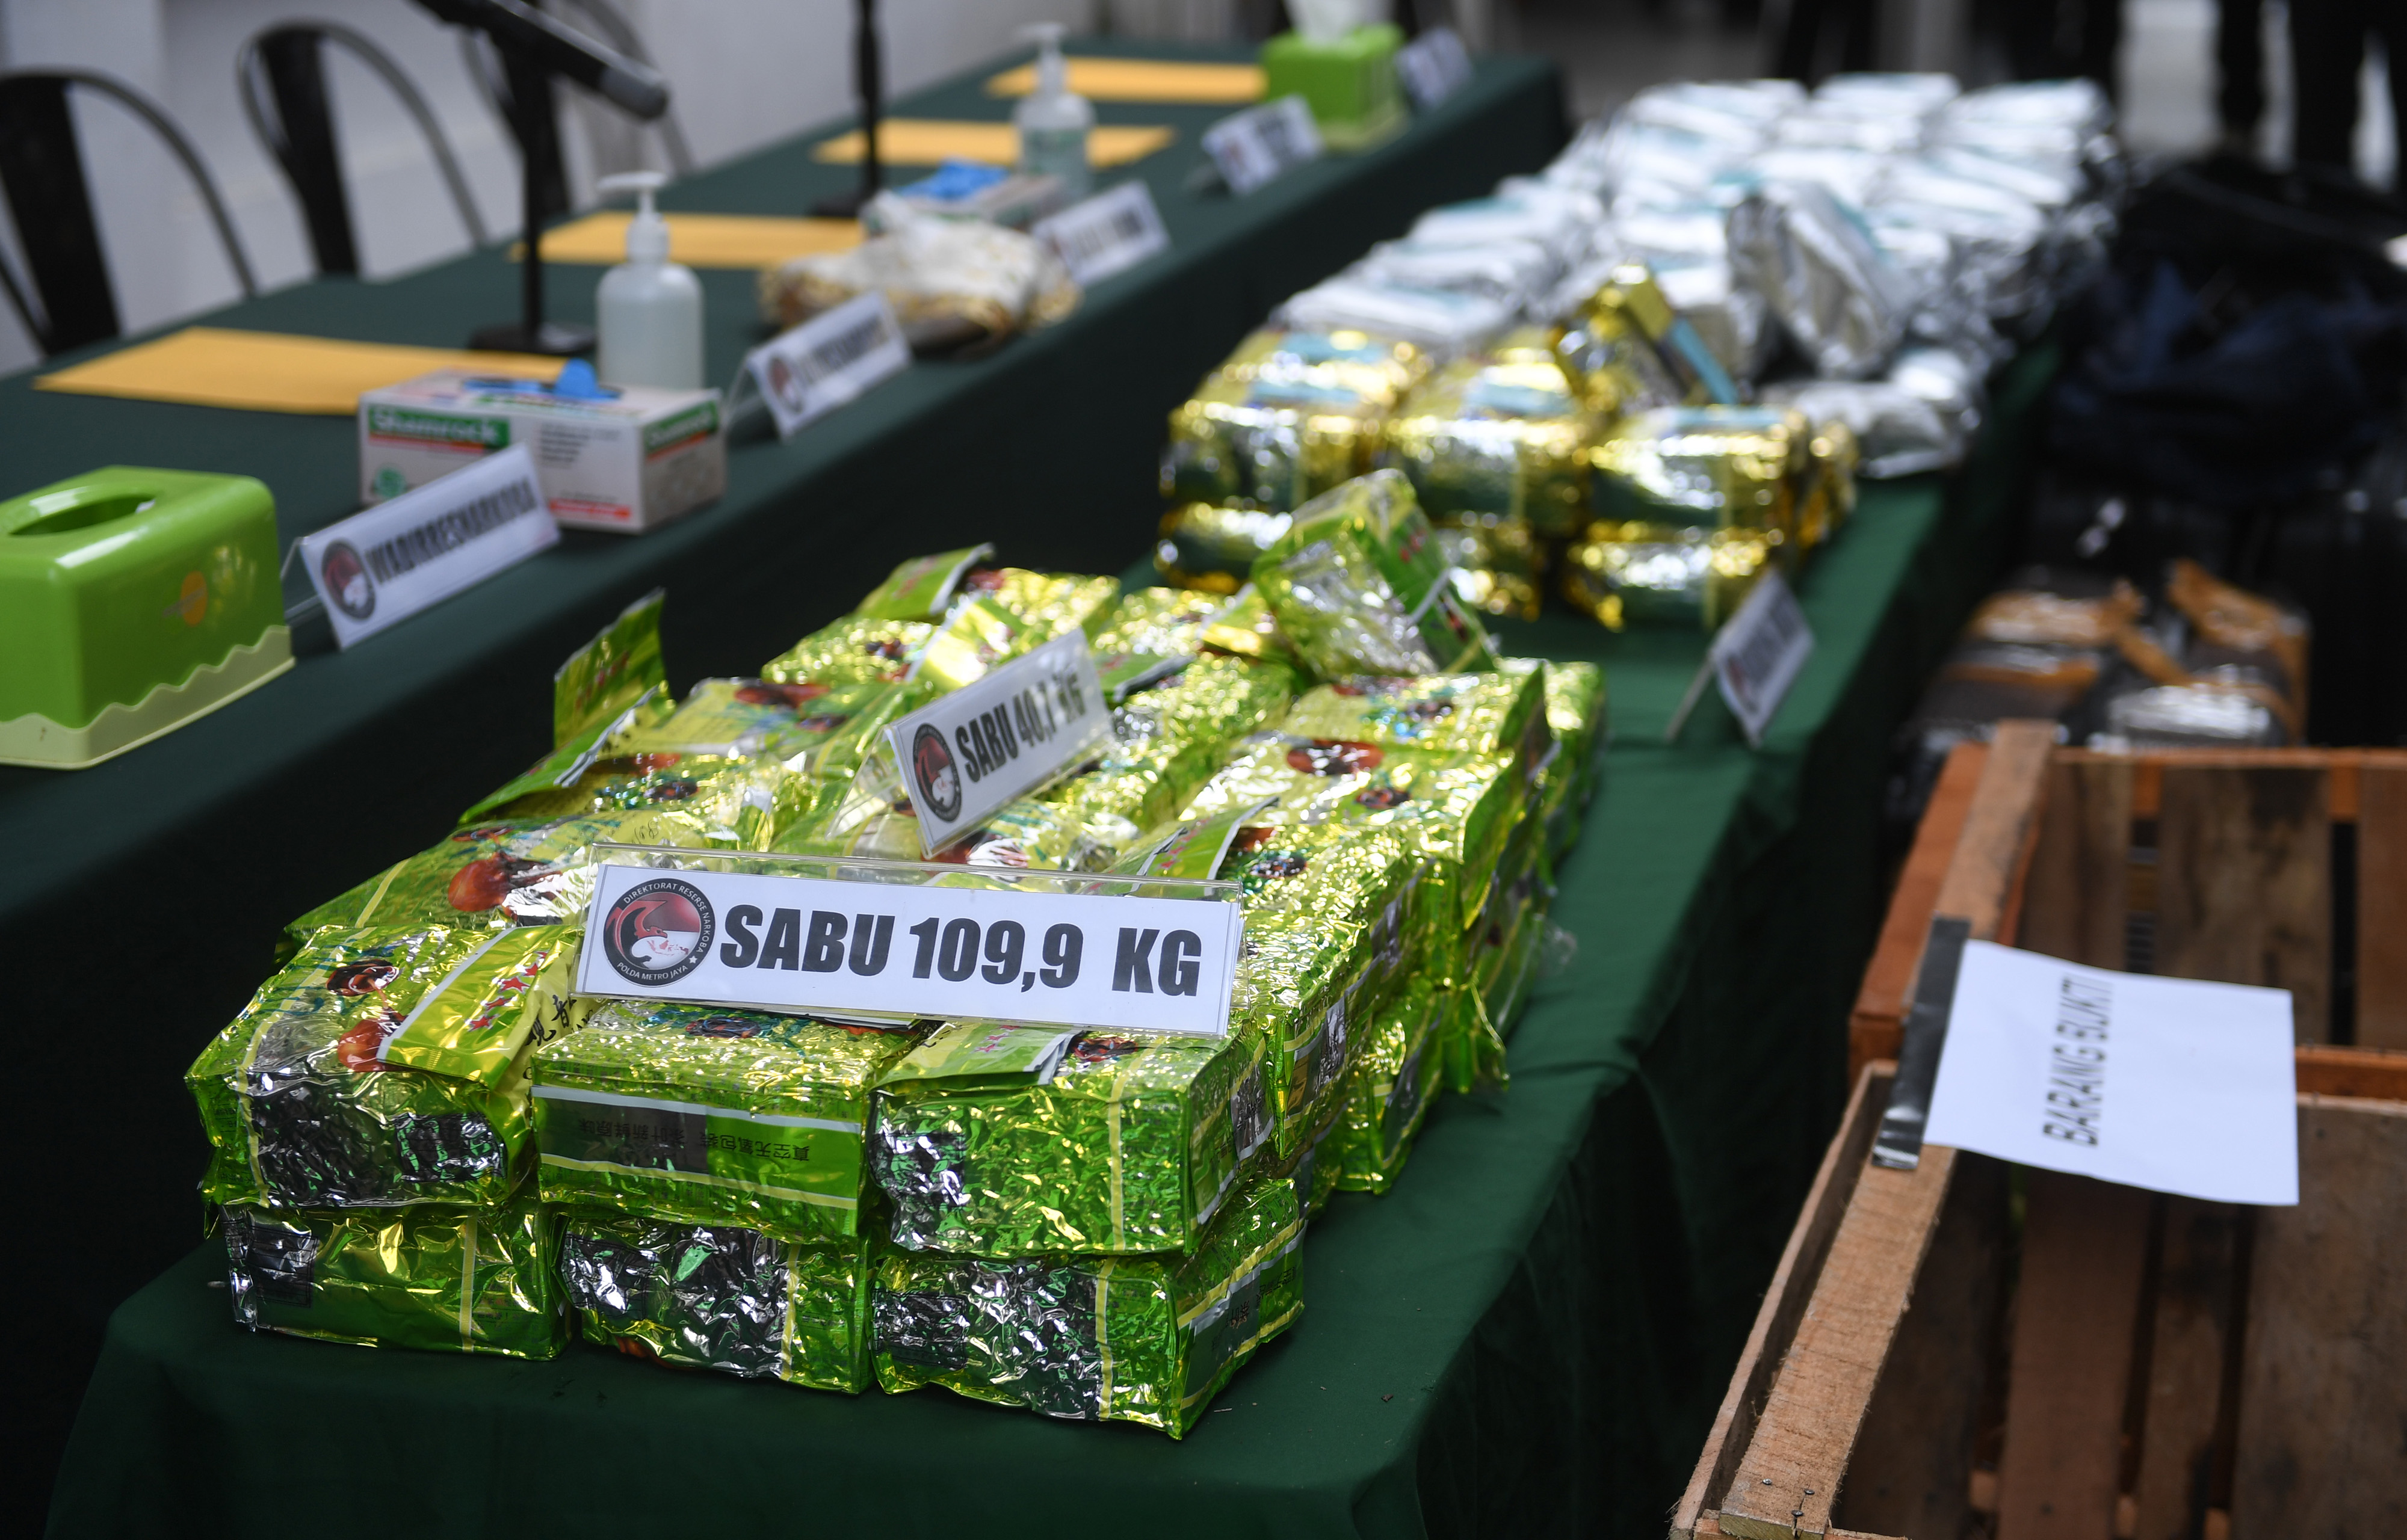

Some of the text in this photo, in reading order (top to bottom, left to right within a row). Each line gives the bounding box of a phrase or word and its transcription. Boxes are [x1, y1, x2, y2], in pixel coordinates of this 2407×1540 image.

[374, 405, 498, 443] Shamrock
[955, 702, 1019, 783] SABU
[623, 882, 712, 953] DIREKTORAT RESERSE NARKOBA
[719, 904, 1202, 997] SABU 109,9 KG
[617, 962, 689, 981] POLDA METRO JAYA
[2043, 974, 2113, 1148] BARANG BUKTI
[700, 1131, 810, 1162] 真空无氧包装
